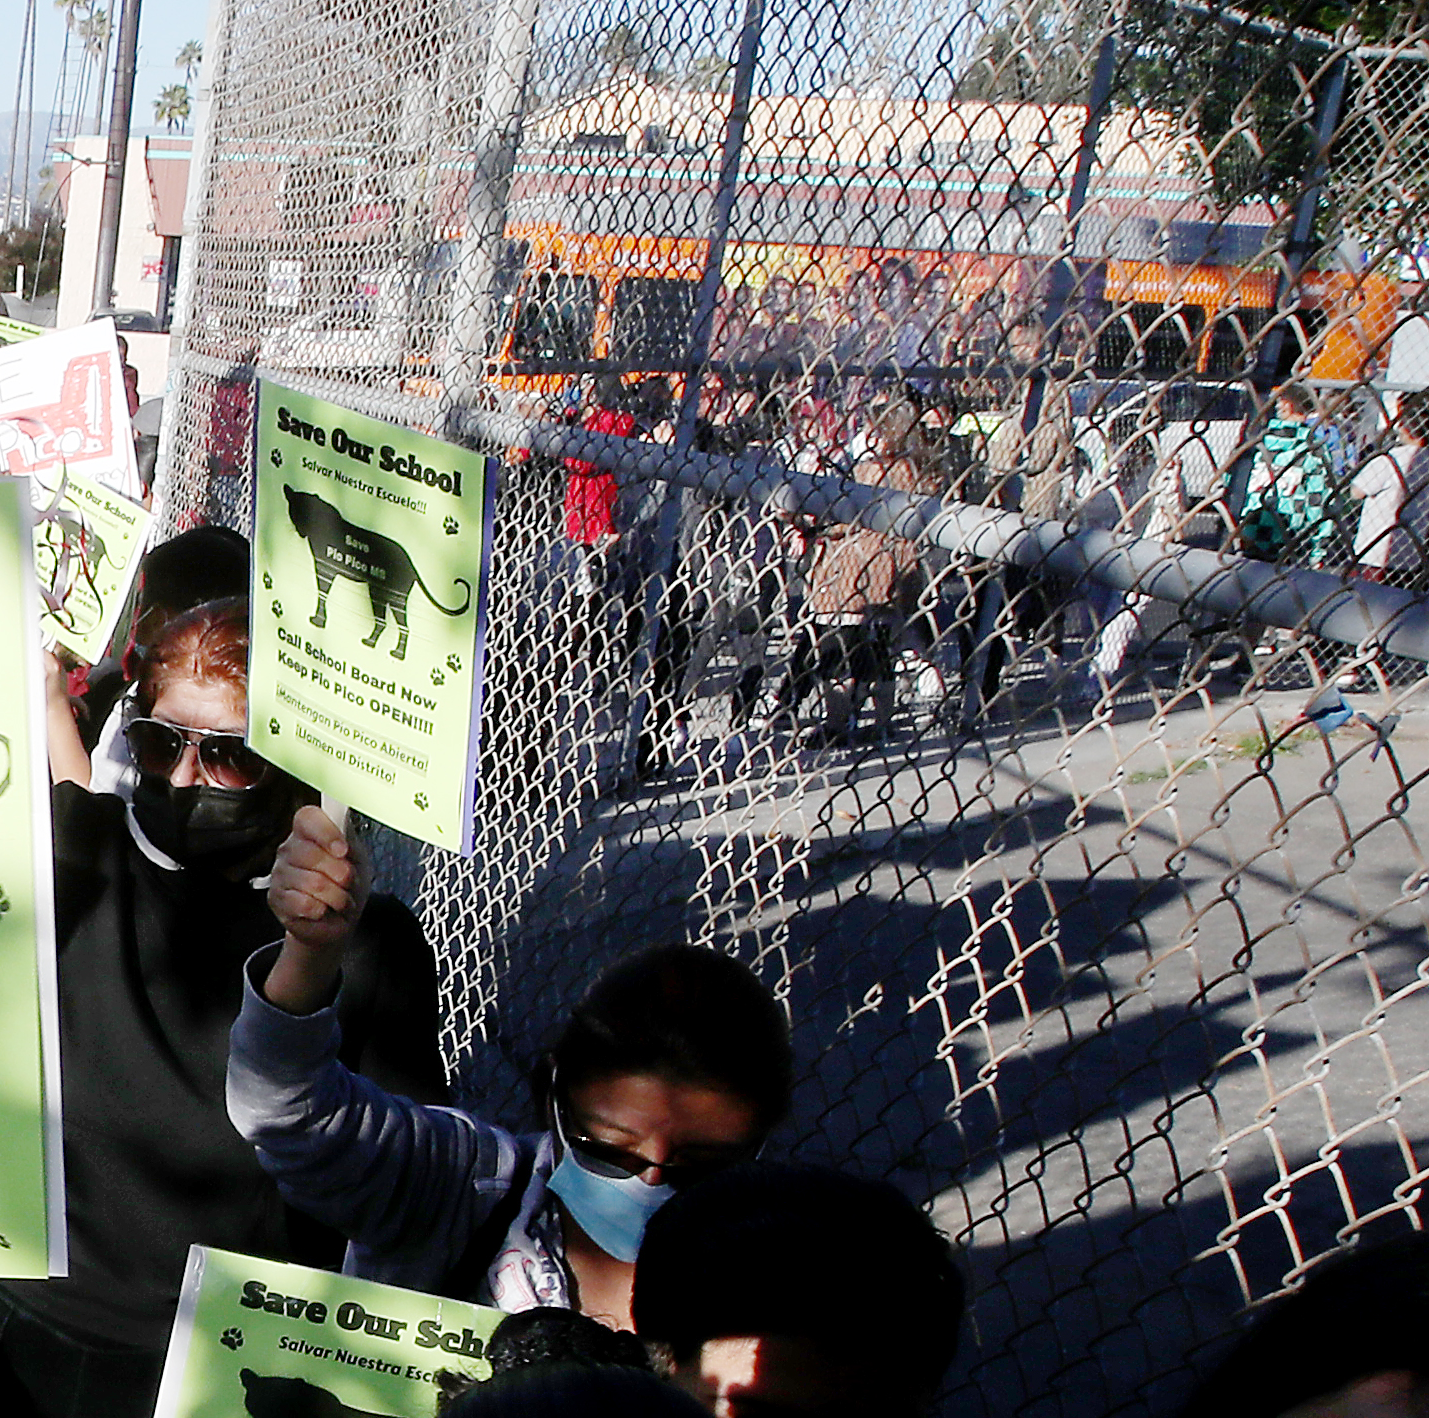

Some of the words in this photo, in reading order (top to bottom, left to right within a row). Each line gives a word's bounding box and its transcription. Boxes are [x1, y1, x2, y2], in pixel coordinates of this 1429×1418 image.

[278, 407, 325, 447] Save
[332, 428, 373, 464] Our
[379, 444, 462, 496] School
[302, 458, 331, 483] Salvar
[336, 469, 373, 496] Nuestra
[377, 484, 426, 514] Escuela!!!
[327, 546, 342, 561] Pio
[345, 553, 367, 571] Pico
[278, 626, 301, 652] Call
[305, 641, 346, 674] School
[352, 662, 394, 695] Board
[401, 685, 437, 711] Now
[278, 651, 306, 679] Keep
[312, 665, 329, 688] Pio
[335, 680, 364, 705] Pico
[334, 717, 349, 737] Pio
[353, 727, 377, 749] Pico
[381, 739, 427, 772] Abierta!
[349, 751, 395, 784] Distrito!
[240, 1280, 329, 1325] Save
[336, 1301, 407, 1342] Our
[415, 1319, 486, 1360] Sch
[278, 1335, 333, 1360] Salvar
[335, 1348, 400, 1378] Nuestra
